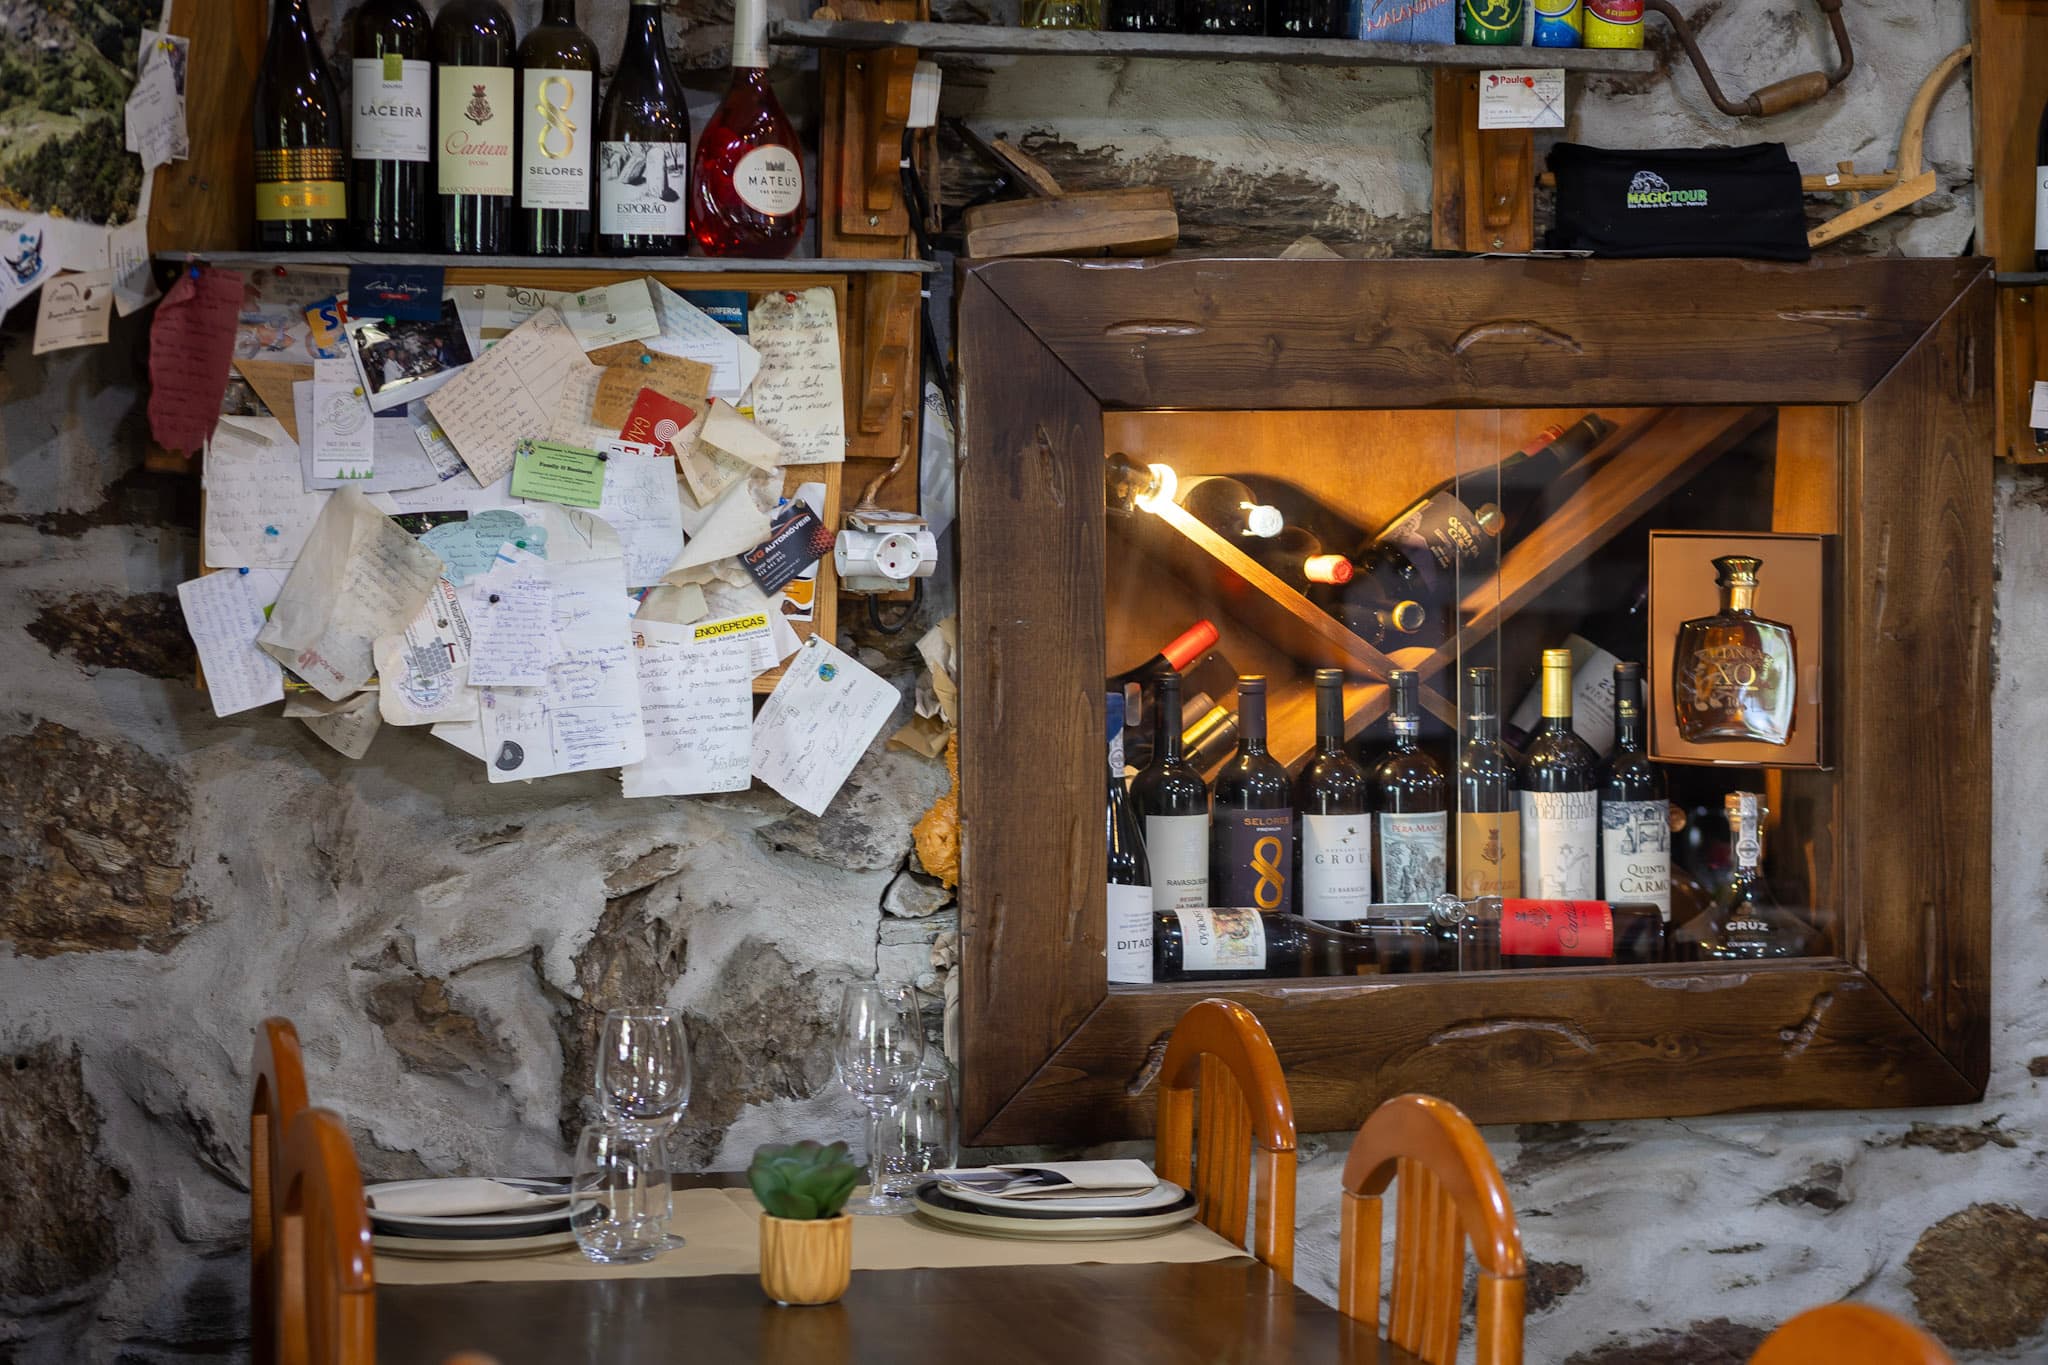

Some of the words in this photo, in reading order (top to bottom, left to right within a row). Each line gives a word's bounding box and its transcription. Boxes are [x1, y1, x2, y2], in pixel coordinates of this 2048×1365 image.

[360, 105, 423, 118] LACEIRA
[529, 166, 584, 177] SELORES
[748, 176, 798, 188] MATEUS
[1627, 189, 1708, 204] MAGICTOUR
[616, 202, 667, 214] ESPORÃO
[1725, 921, 1769, 932] CRUZ
